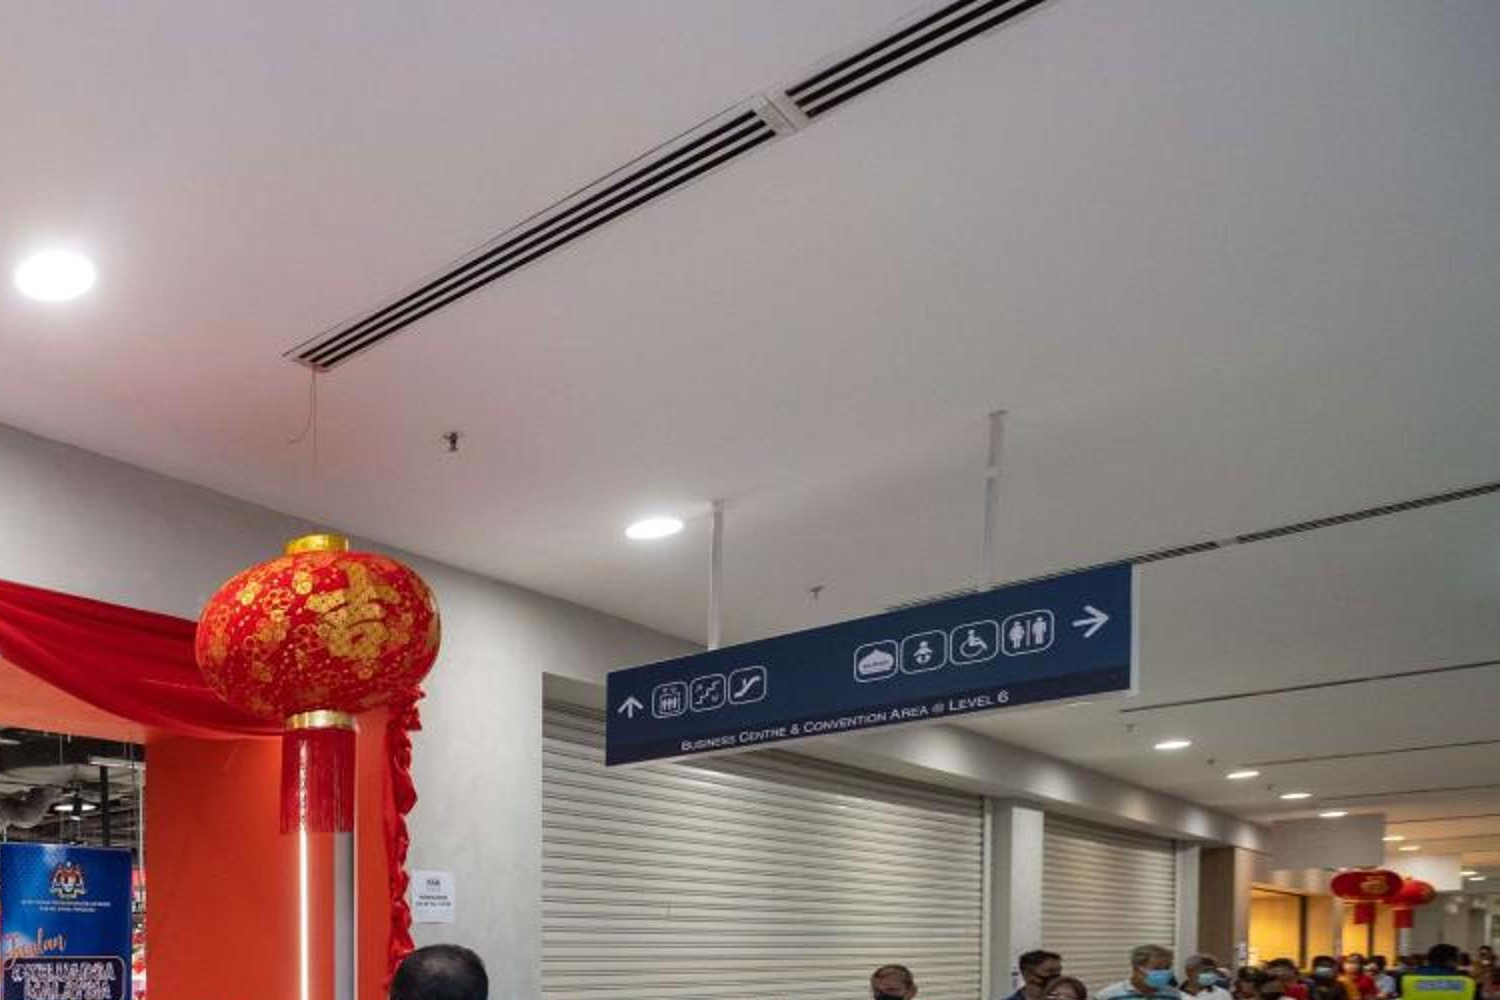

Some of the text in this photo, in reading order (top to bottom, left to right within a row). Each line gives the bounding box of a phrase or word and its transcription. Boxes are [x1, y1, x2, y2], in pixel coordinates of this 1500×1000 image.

[681, 735, 737, 750] BUSINESS
[739, 728, 787, 743] CENTRE
[790, 723, 800, 736] &
[803, 711, 887, 733] CONVENTION
[889, 705, 929, 721] AREA
[949, 695, 994, 711] LEVEL
[997, 690, 1009, 703] 6
